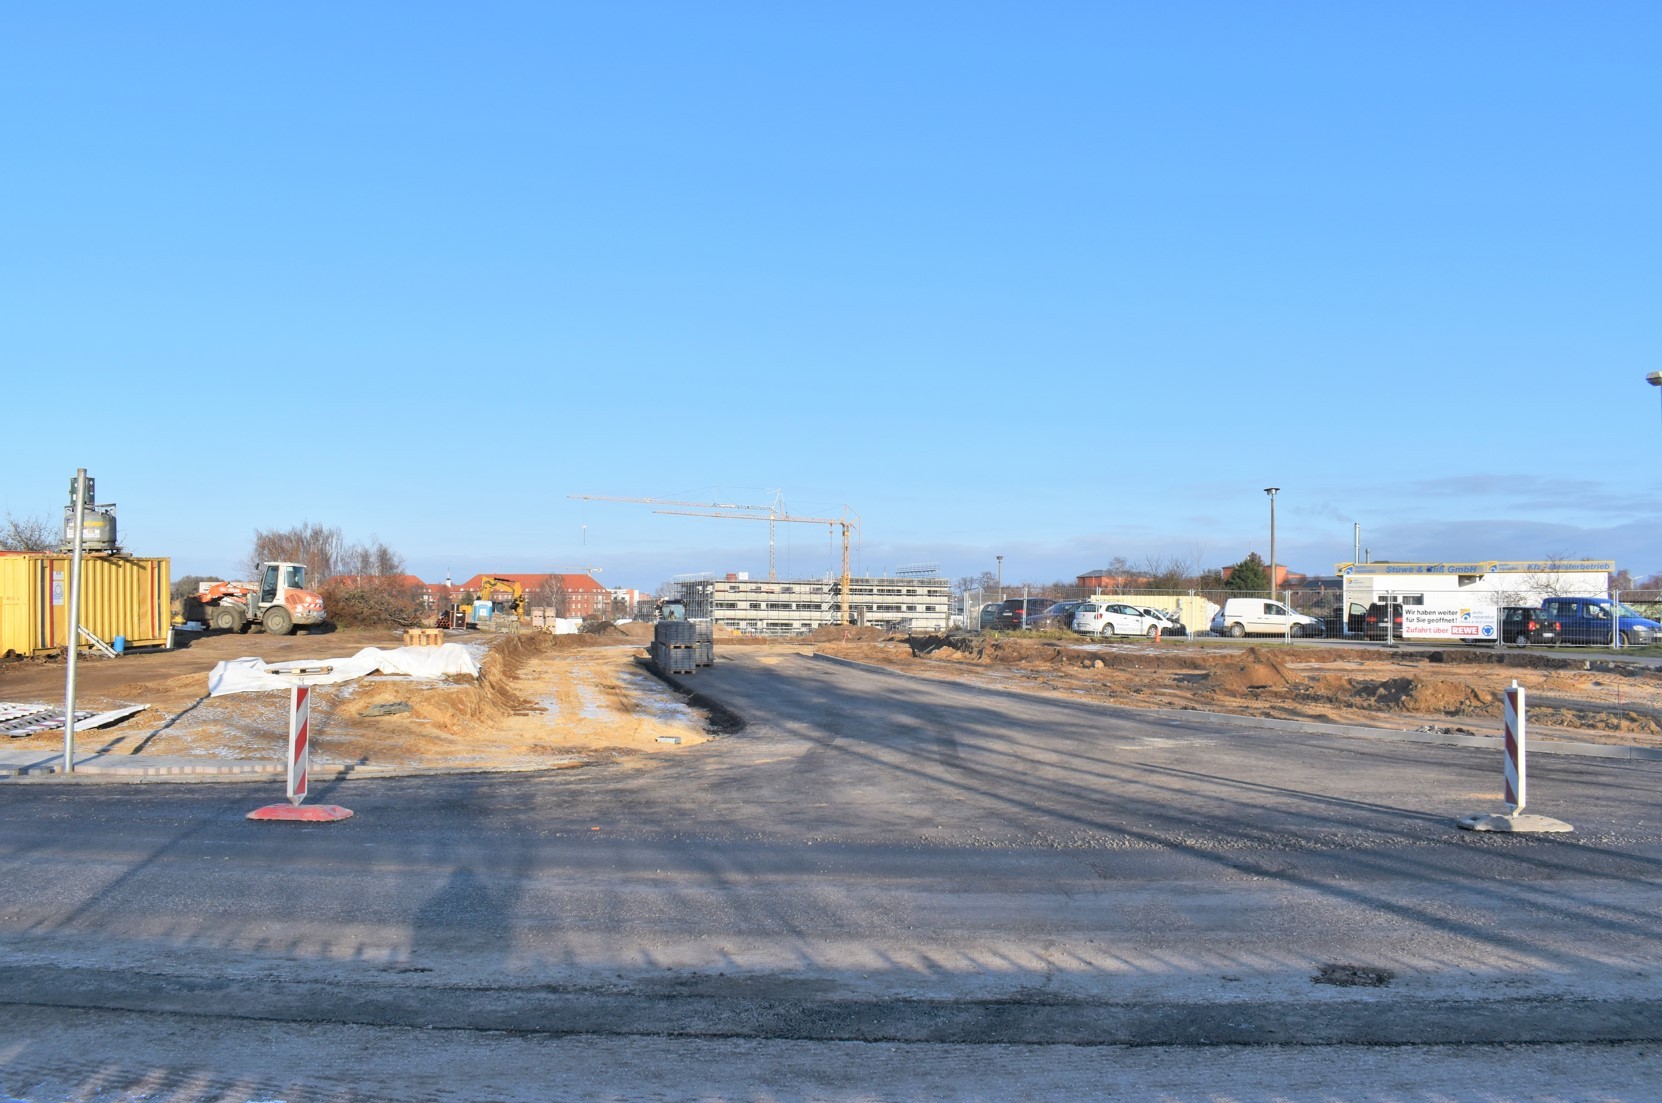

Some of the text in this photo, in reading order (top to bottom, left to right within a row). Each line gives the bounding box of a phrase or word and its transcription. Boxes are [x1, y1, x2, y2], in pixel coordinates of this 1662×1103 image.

[1416, 565, 1423, 573] &
[1447, 565, 1477, 573] GmbH
[1527, 563, 1541, 571] Kfz
[1549, 562, 1610, 571] Meisterbetrieb
[1453, 626, 1477, 634] REWE
